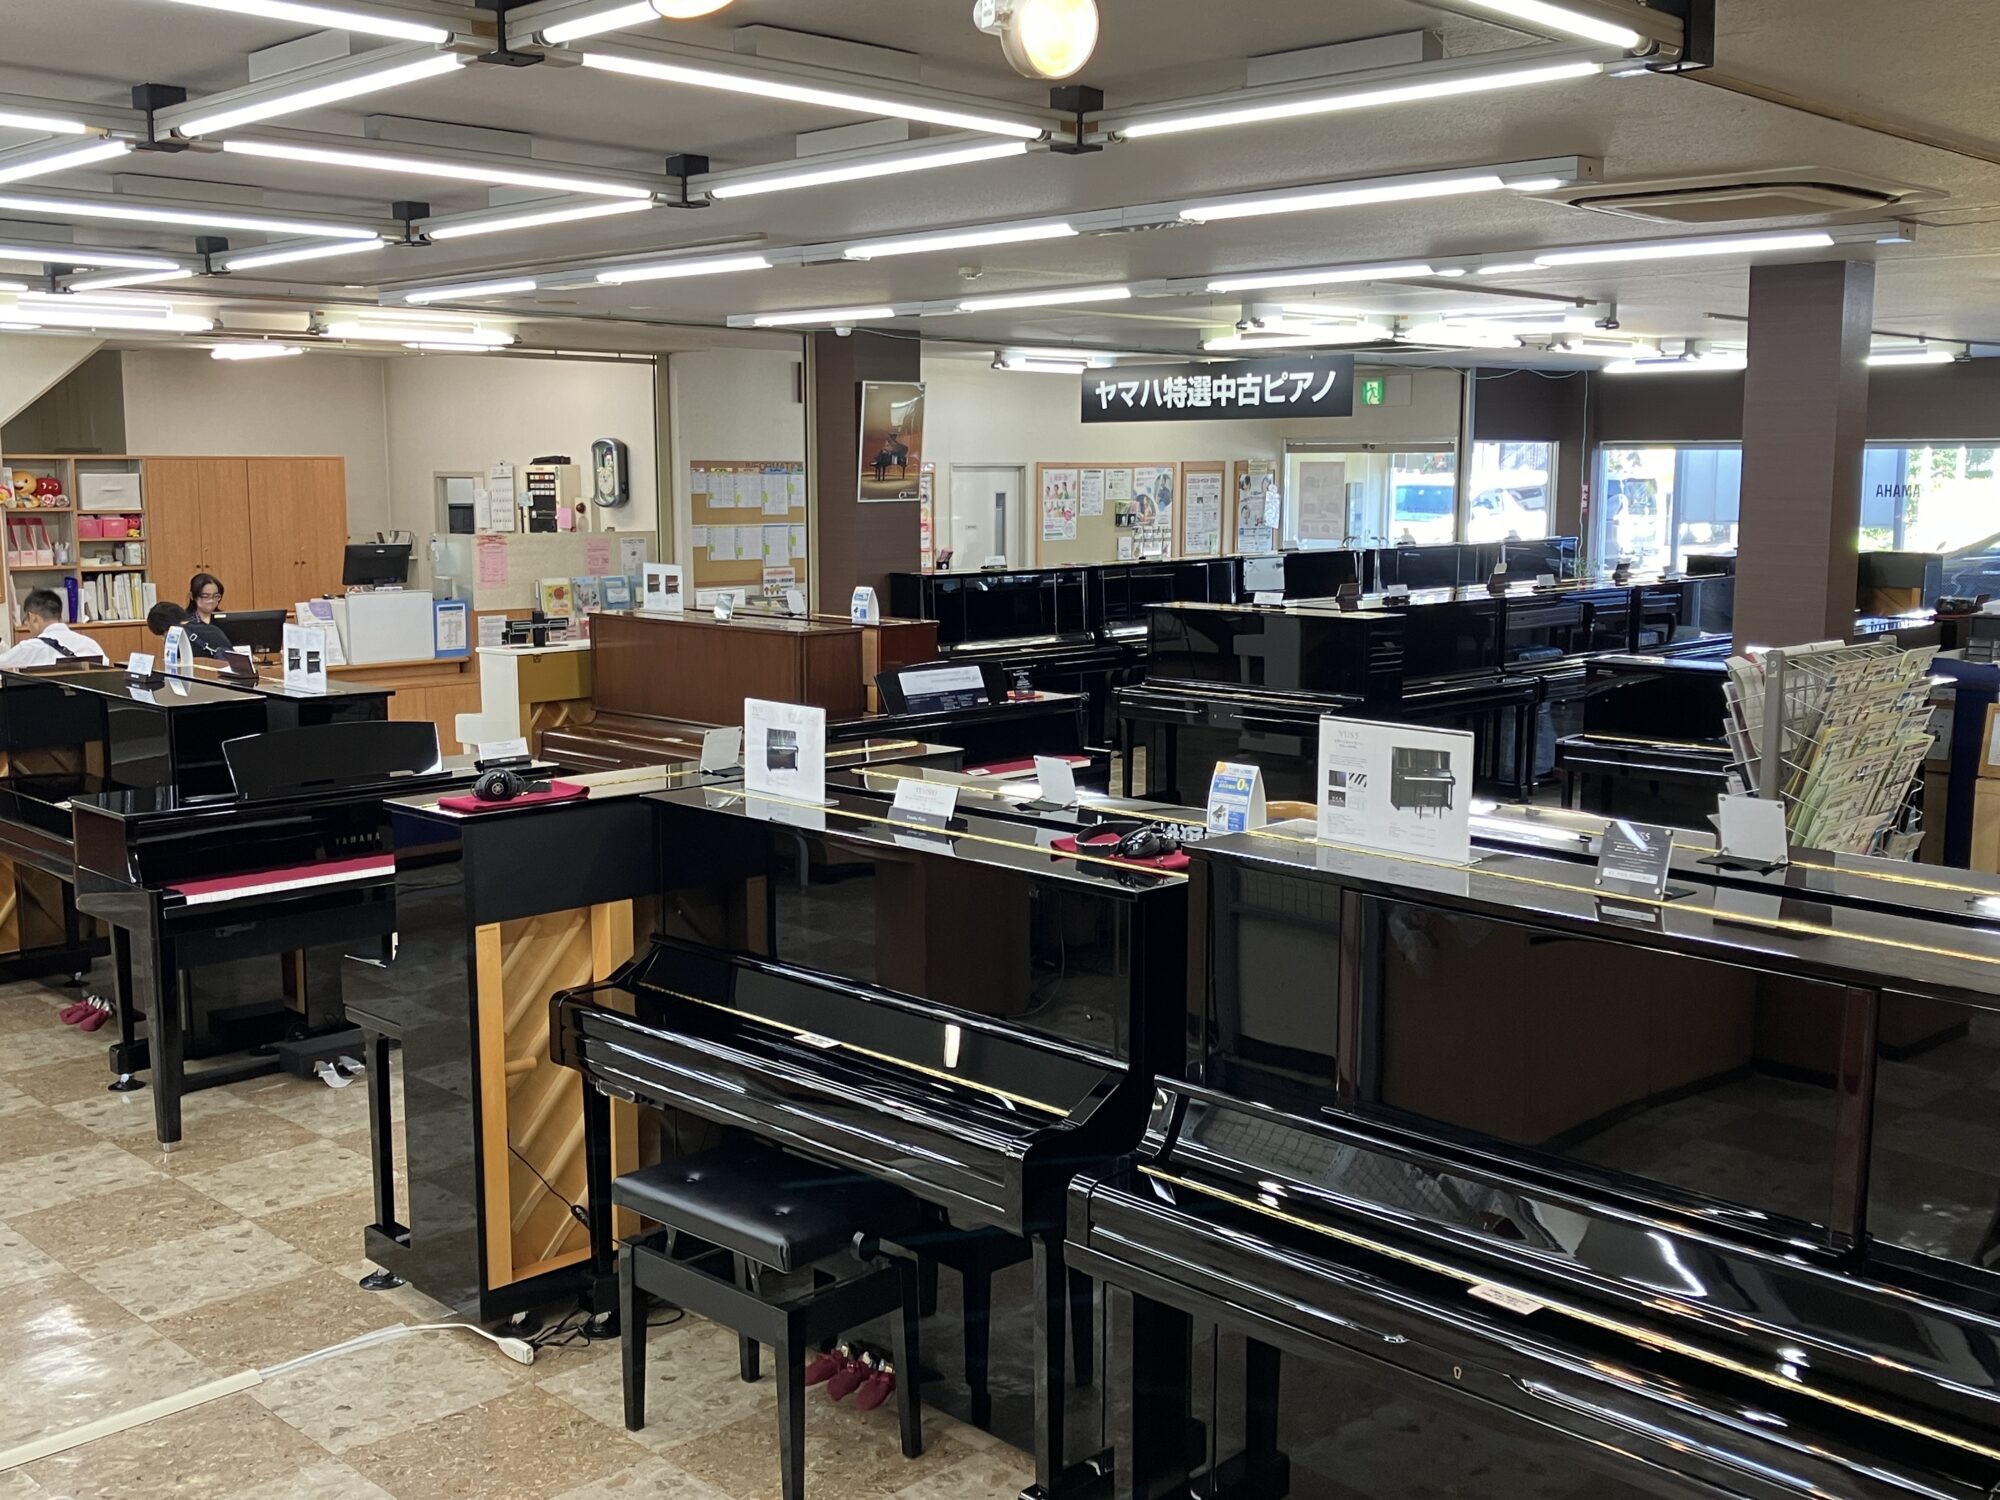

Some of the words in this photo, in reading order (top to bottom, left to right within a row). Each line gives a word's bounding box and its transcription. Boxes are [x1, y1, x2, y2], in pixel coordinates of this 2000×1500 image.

[1095, 370, 1337, 410] ヤマハ特選中古ピアノ
